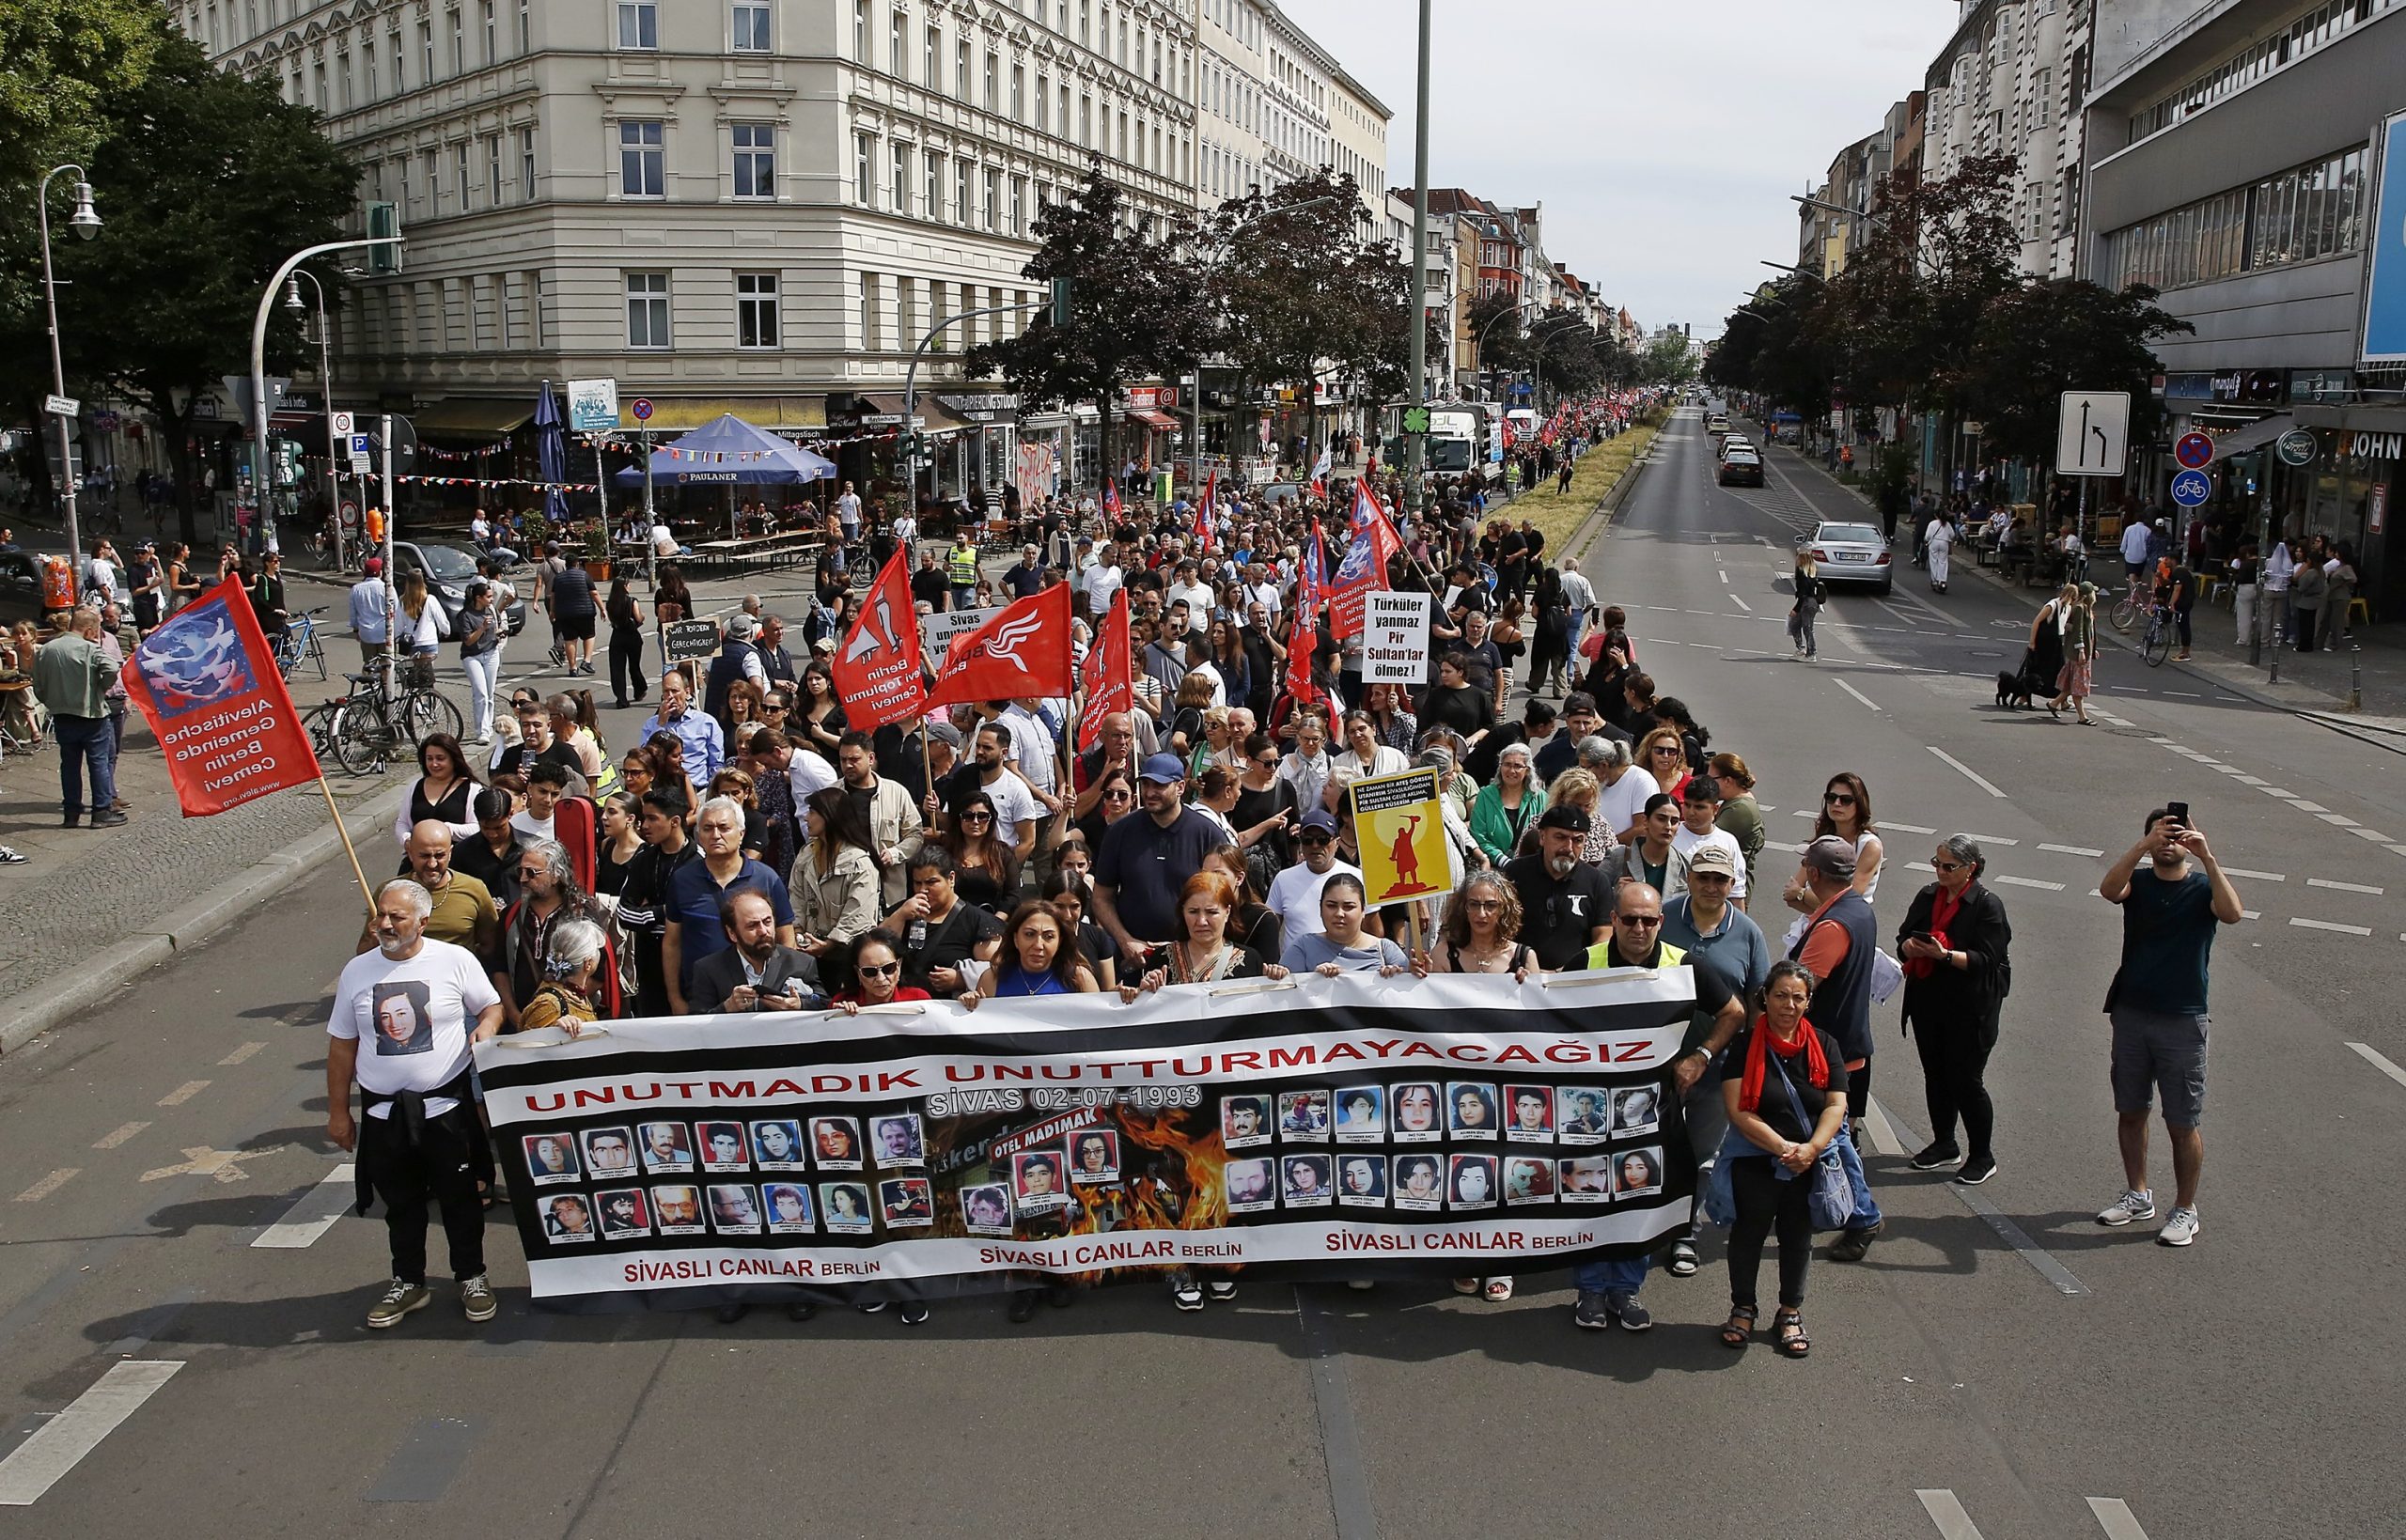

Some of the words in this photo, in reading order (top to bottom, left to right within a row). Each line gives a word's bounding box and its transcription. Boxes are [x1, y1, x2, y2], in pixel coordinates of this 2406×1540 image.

[996, 394, 1018, 410] STUDIO
[338, 418, 347, 428] 30
[778, 430, 820, 442] Mittagstisch
[356, 438, 365, 450] P
[2350, 432, 2402, 459] JOHN
[690, 473, 738, 481] PAULANER
[1373, 598, 1423, 612] Türküler
[949, 614, 980, 626] Sivas
[1375, 615, 1419, 629] yanmaz
[669, 627, 682, 635] WIR
[1388, 631, 1405, 644] Pir
[1374, 664, 1409, 677] ölmez
[1411, 664, 1415, 677] !
[1409, 775, 1432, 784] GÖRSEM
[1357, 789, 1386, 799] UTANIRIM
[1369, 796, 1391, 804] SULTAN
[1385, 799, 1411, 807] KÜSERİM
[524, 1067, 924, 1112] UNUTMADIK
[945, 1039, 1655, 1082] UNUTTURMAYACAĞIZ
[929, 1087, 1023, 1117] SİVAS
[1034, 1084, 1202, 1109] 02-07-1993
[994, 1140, 1022, 1159] OTEL
[1024, 1108, 1098, 1147] MADIMAK
[1326, 1228, 1416, 1252] SİVASLI
[1423, 1231, 1524, 1251] CANLAR
[1532, 1232, 1594, 1249] BERLİN
[980, 1246, 1068, 1268] SİVASLI
[1075, 1240, 1174, 1265] CANLAR
[1181, 1242, 1242, 1257] BERLİN
[624, 1259, 711, 1283] SİVASLI
[719, 1258, 814, 1277] CANLAR
[821, 1260, 881, 1276] BERLİN
